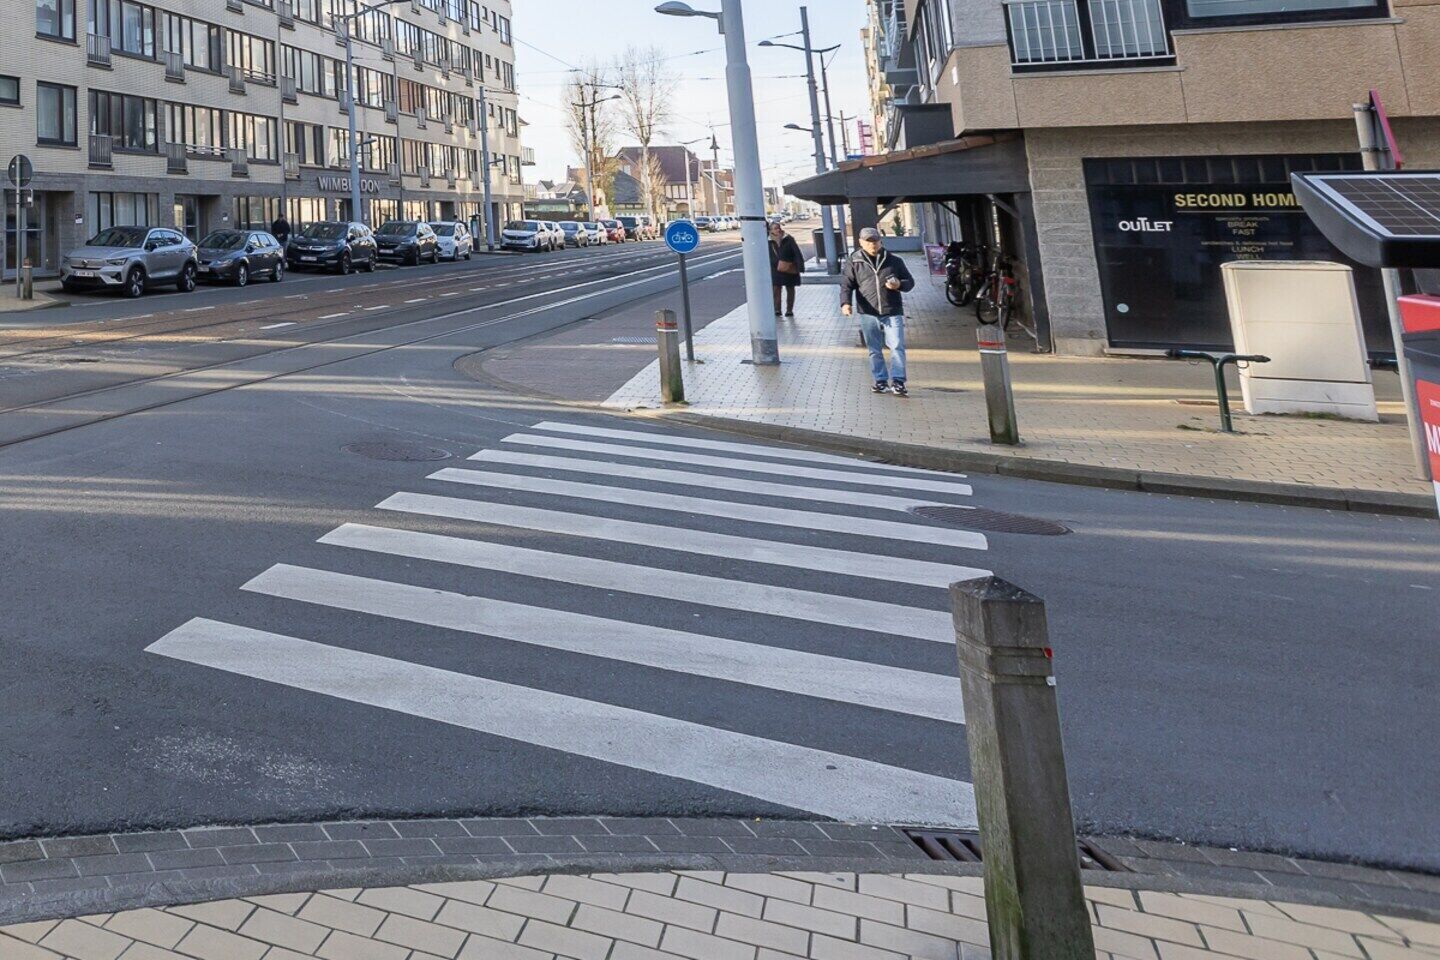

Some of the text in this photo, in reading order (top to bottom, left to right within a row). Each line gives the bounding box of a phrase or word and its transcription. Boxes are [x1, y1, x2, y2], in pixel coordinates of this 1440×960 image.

[318, 176, 380, 193] WIMBLDON
[1174, 193, 1246, 207] SECOND
[1118, 216, 1173, 232] OUTLET
